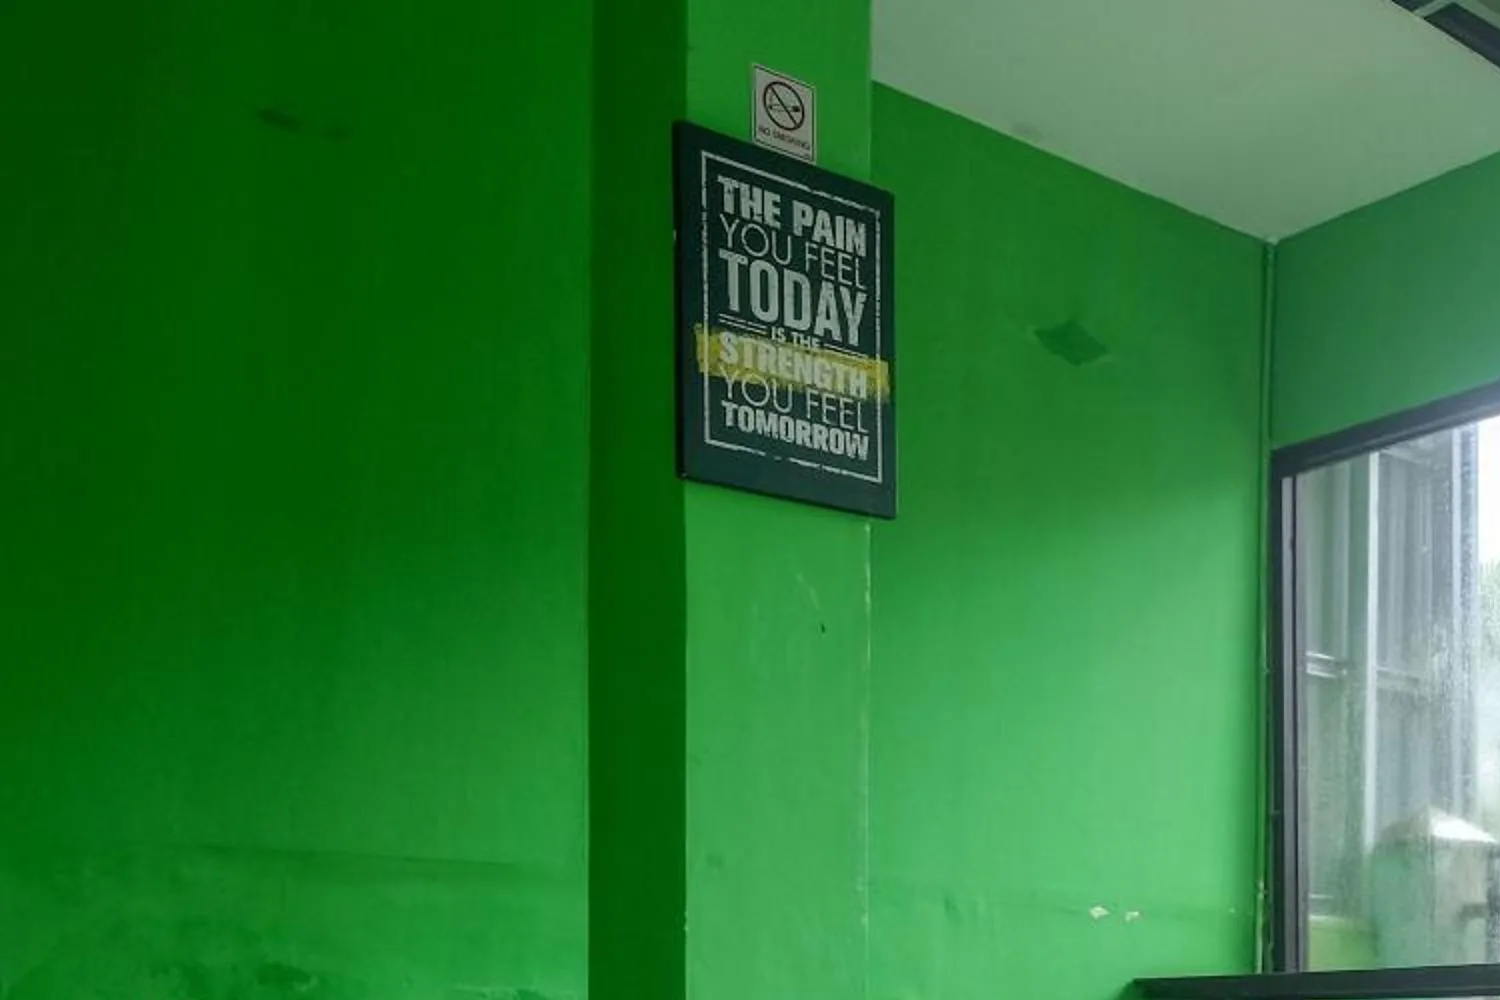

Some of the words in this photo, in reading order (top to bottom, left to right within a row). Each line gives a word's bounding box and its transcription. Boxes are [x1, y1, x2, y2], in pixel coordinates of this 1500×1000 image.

[718, 175, 782, 229] THE
[793, 200, 867, 258] PAIN
[720, 214, 792, 266] YOU
[805, 241, 867, 290] FEEL
[718, 248, 868, 347] TODAY
[719, 330, 868, 399] STRENGTH
[771, 326, 786, 343] IS
[792, 331, 821, 351] THE
[720, 365, 793, 414] YOU
[806, 388, 870, 433] FEEL
[721, 399, 870, 461] TOMORROW
